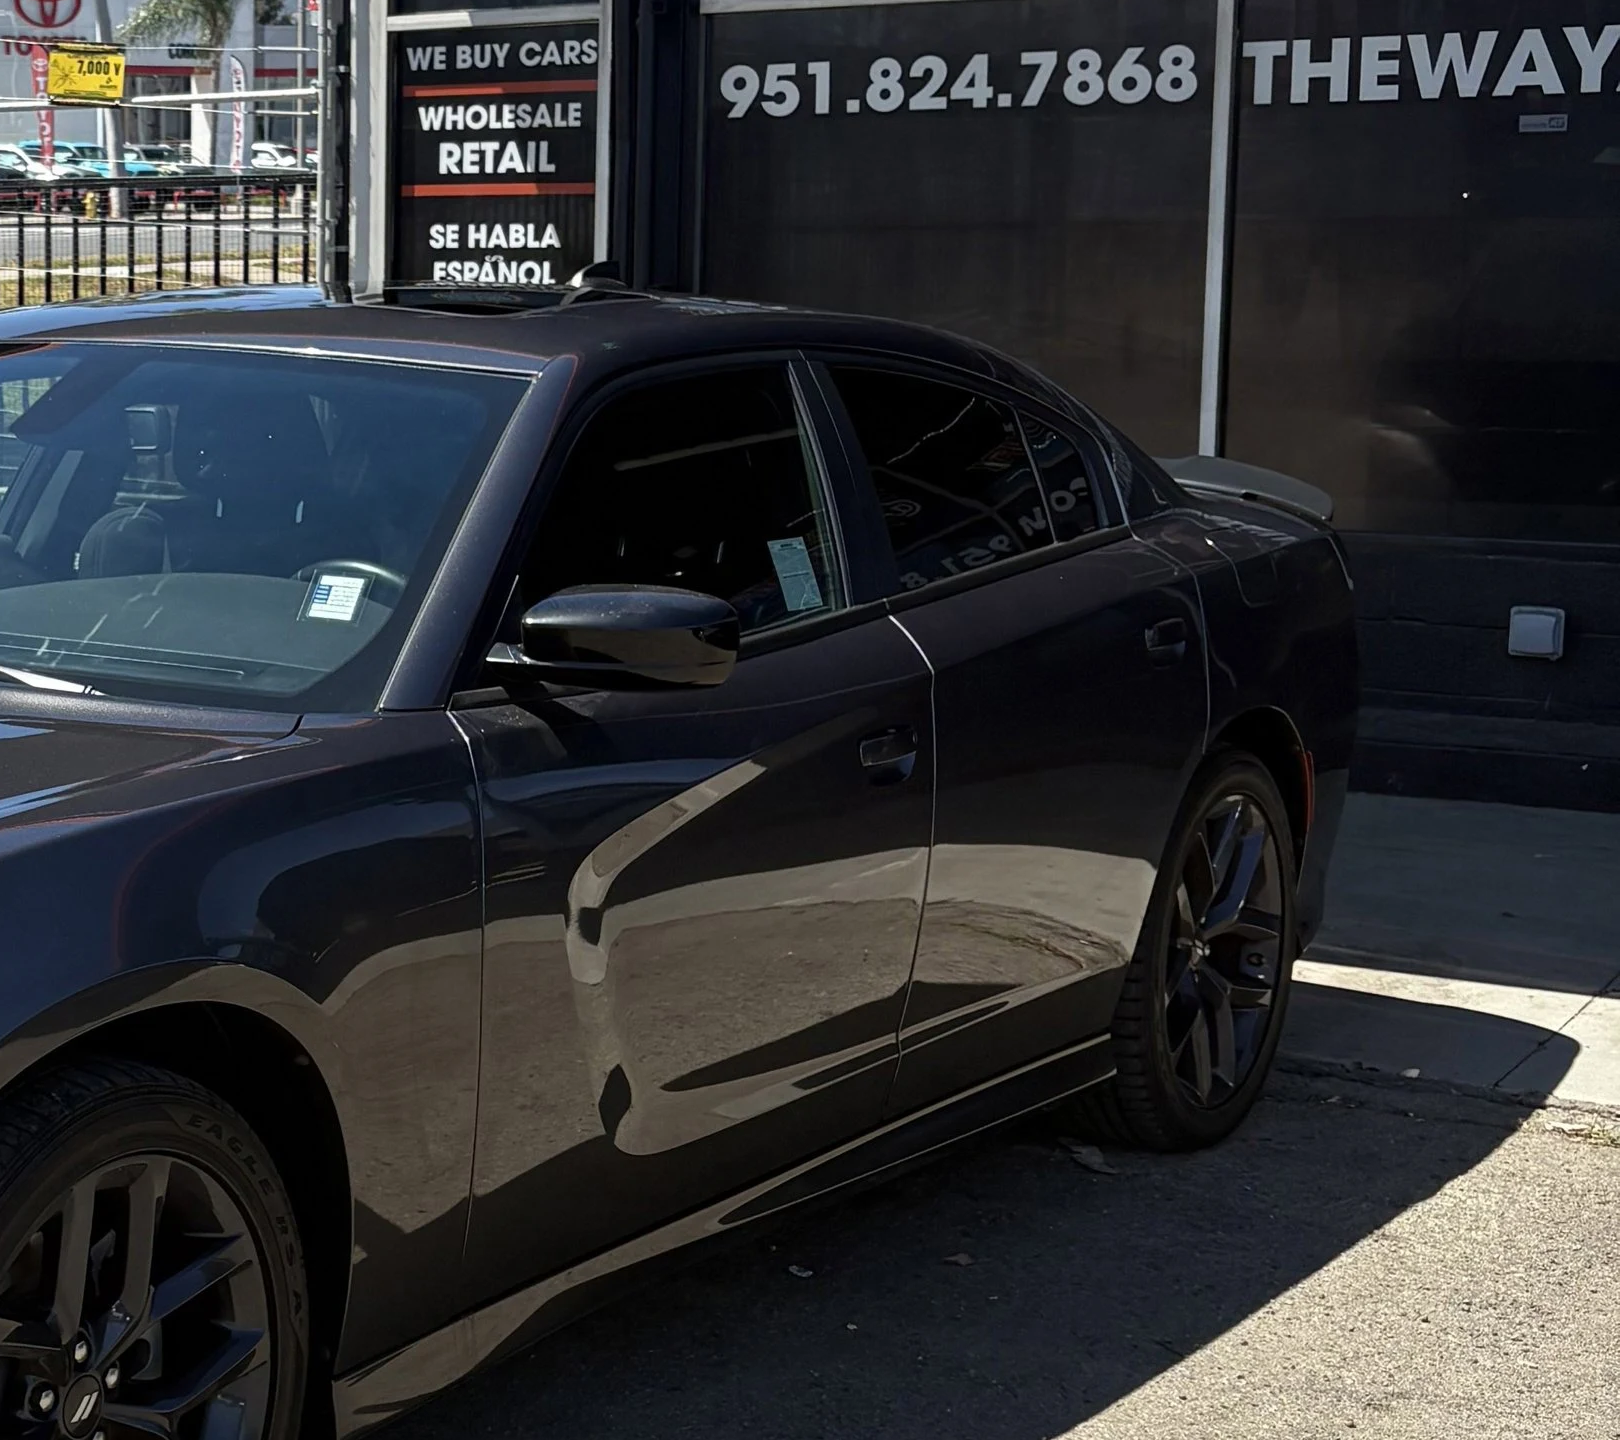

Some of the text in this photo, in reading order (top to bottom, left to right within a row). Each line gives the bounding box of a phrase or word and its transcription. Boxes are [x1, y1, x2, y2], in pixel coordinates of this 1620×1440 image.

[77, 60, 121, 76] 7,000 V
[406, 39, 598, 71] WE BUY CARS
[1242, 24, 1620, 105] THEWAY
[720, 44, 1198, 119] 951.824.7868
[418, 102, 582, 131] WHOLESALE
[439, 140, 556, 174] RETAIL
[429, 223, 561, 249] SE HABLA
[186, 1113, 276, 1197] EAGLE
